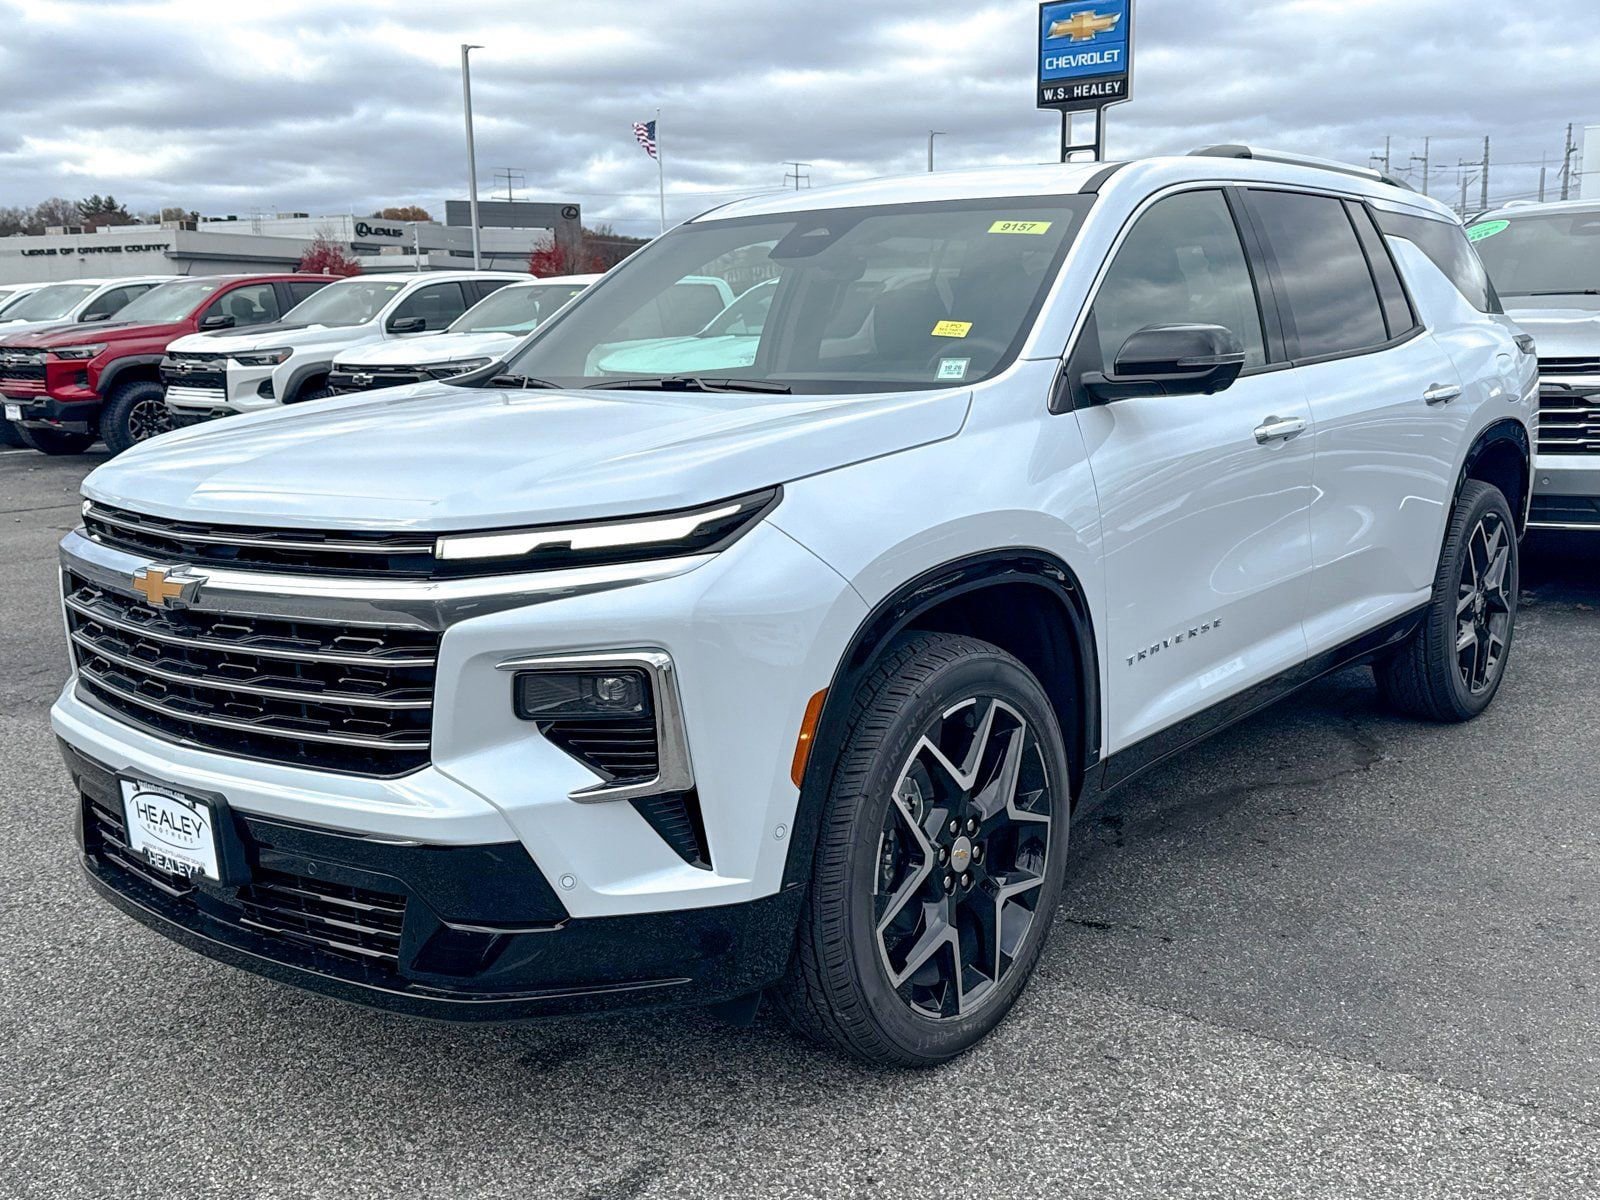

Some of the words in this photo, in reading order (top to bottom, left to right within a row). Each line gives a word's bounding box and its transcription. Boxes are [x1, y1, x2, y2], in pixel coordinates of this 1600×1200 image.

[1045, 50, 1120, 70] CHEVROLET
[1043, 87, 1069, 101] W.S.
[1073, 81, 1121, 98] HEALEY
[369, 226, 403, 238] LEXUS
[1000, 222, 1037, 232] 9157
[22, 247, 57, 257] LEXUS
[60, 247, 75, 256] OF
[77, 245, 122, 255] ORANGE
[124, 243, 170, 253] COUNTY
[1126, 617, 1222, 667] TRAVERSE
[135, 800, 203, 839] HEALEY
[146, 823, 194, 844] BROTHERS
[148, 849, 193, 879] HEALEY
